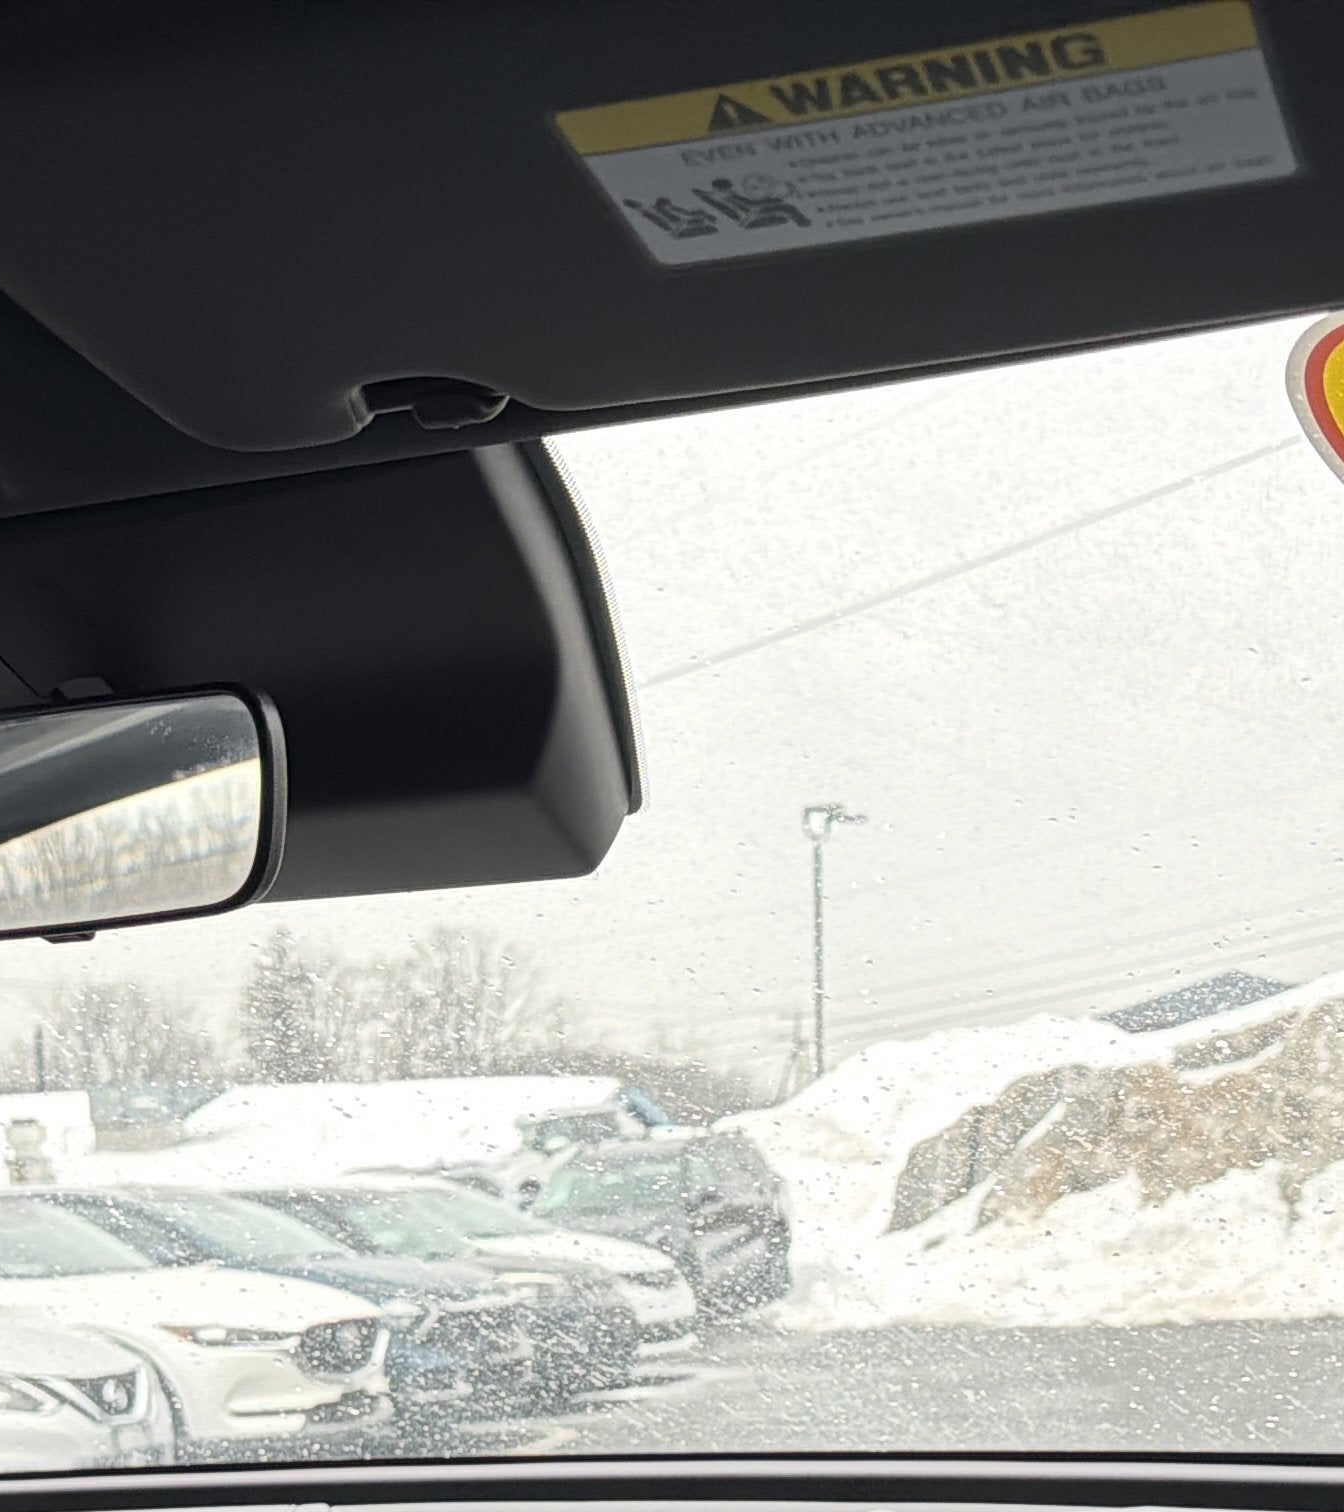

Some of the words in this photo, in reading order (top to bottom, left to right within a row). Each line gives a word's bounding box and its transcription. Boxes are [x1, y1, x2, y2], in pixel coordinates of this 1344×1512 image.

[768, 32, 1107, 117] WARNING
[680, 143, 757, 167] EVEN
[765, 129, 842, 152] WITH
[852, 101, 1007, 140] ADVANCED
[1080, 75, 1168, 104] BAGS
